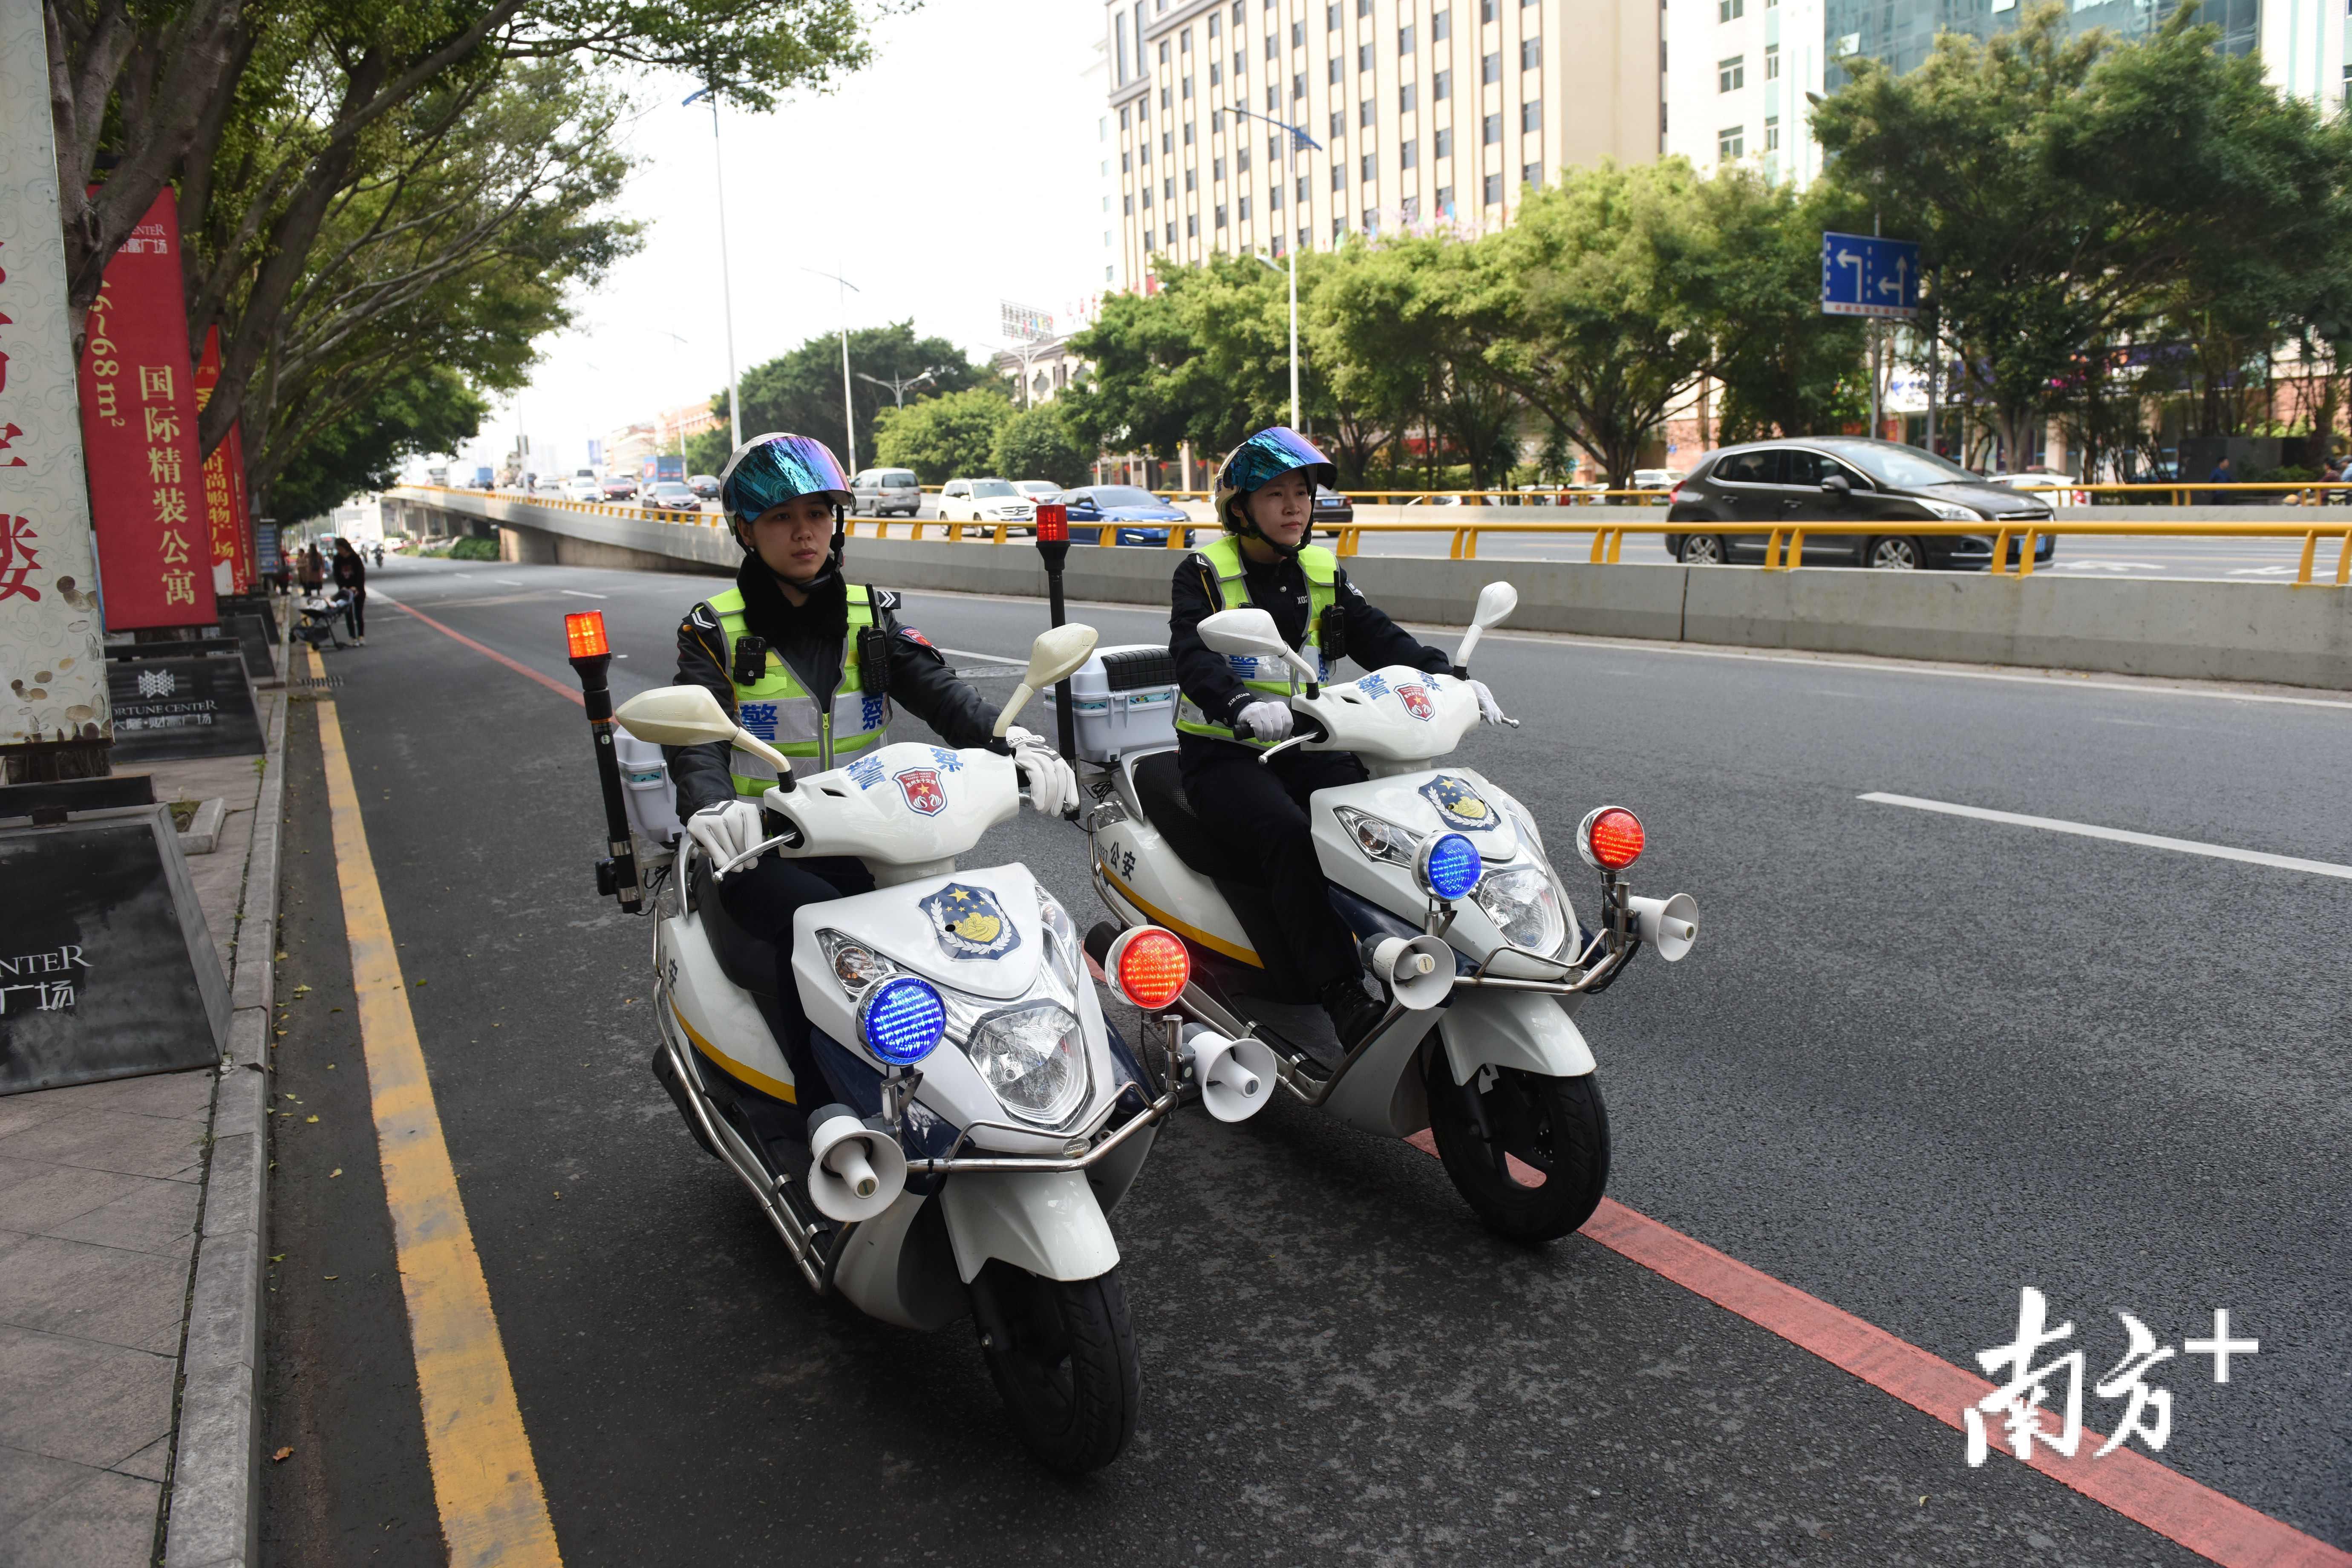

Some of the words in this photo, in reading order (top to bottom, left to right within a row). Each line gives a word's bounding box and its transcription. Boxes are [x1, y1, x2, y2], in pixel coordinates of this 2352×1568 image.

[139, 365, 196, 605] 国际精装公寓
[204, 448, 234, 558] 时尚购物广场
[1356, 674, 1390, 700] 警
[1415, 670, 1442, 692] 察
[165, 700, 219, 712] CENTER
[740, 703, 778, 741] 警
[861, 691, 884, 731] 察
[1007, 736, 1042, 746] POLICE
[845, 755, 886, 791] 警
[929, 747, 964, 772] 察
[1110, 841, 1136, 882] 公安
[0, 945, 95, 978] NTER
[0, 980, 75, 1015] 广场
